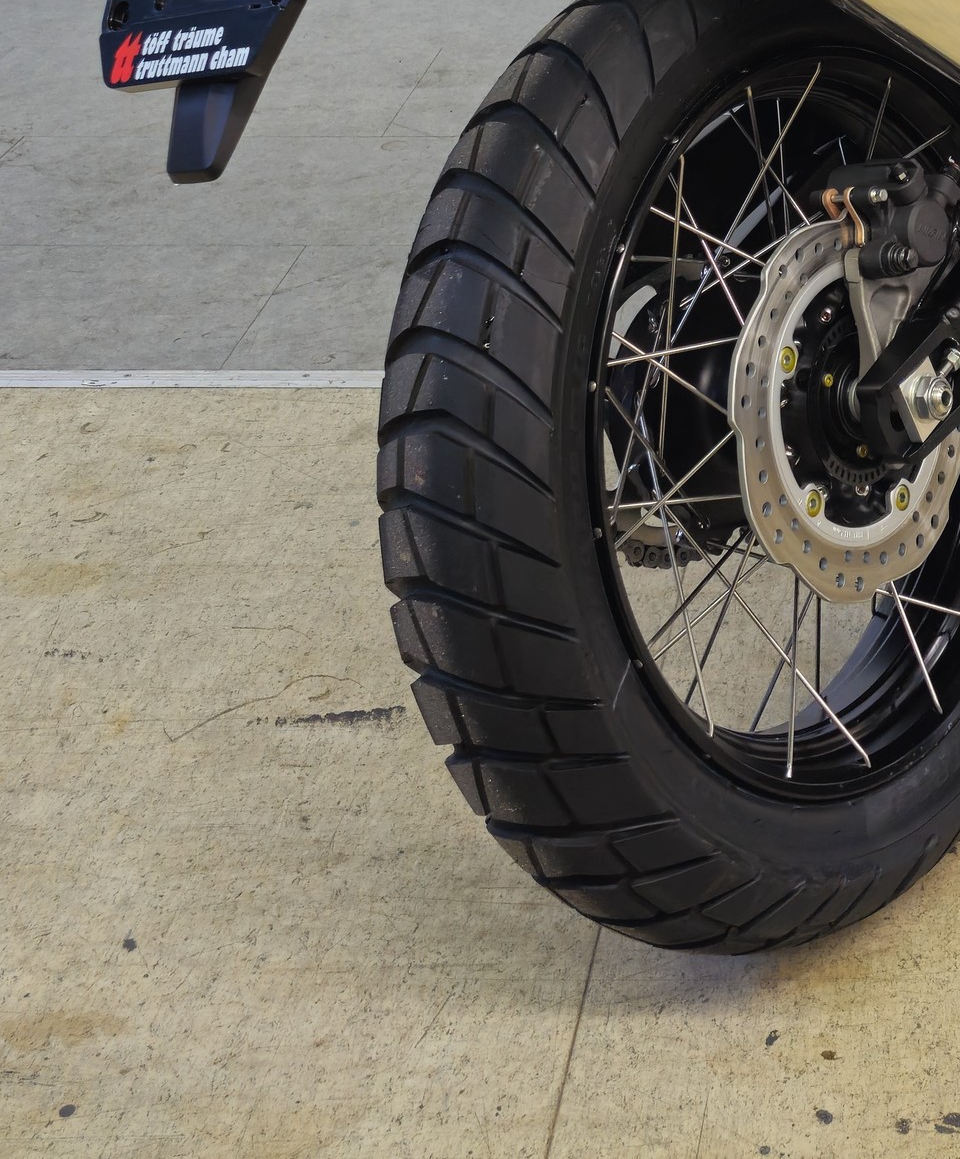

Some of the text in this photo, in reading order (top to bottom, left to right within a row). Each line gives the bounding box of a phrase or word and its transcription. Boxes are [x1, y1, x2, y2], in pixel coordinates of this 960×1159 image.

[141, 25, 225, 56] töff träume
[134, 45, 251, 81] truttmann cham
